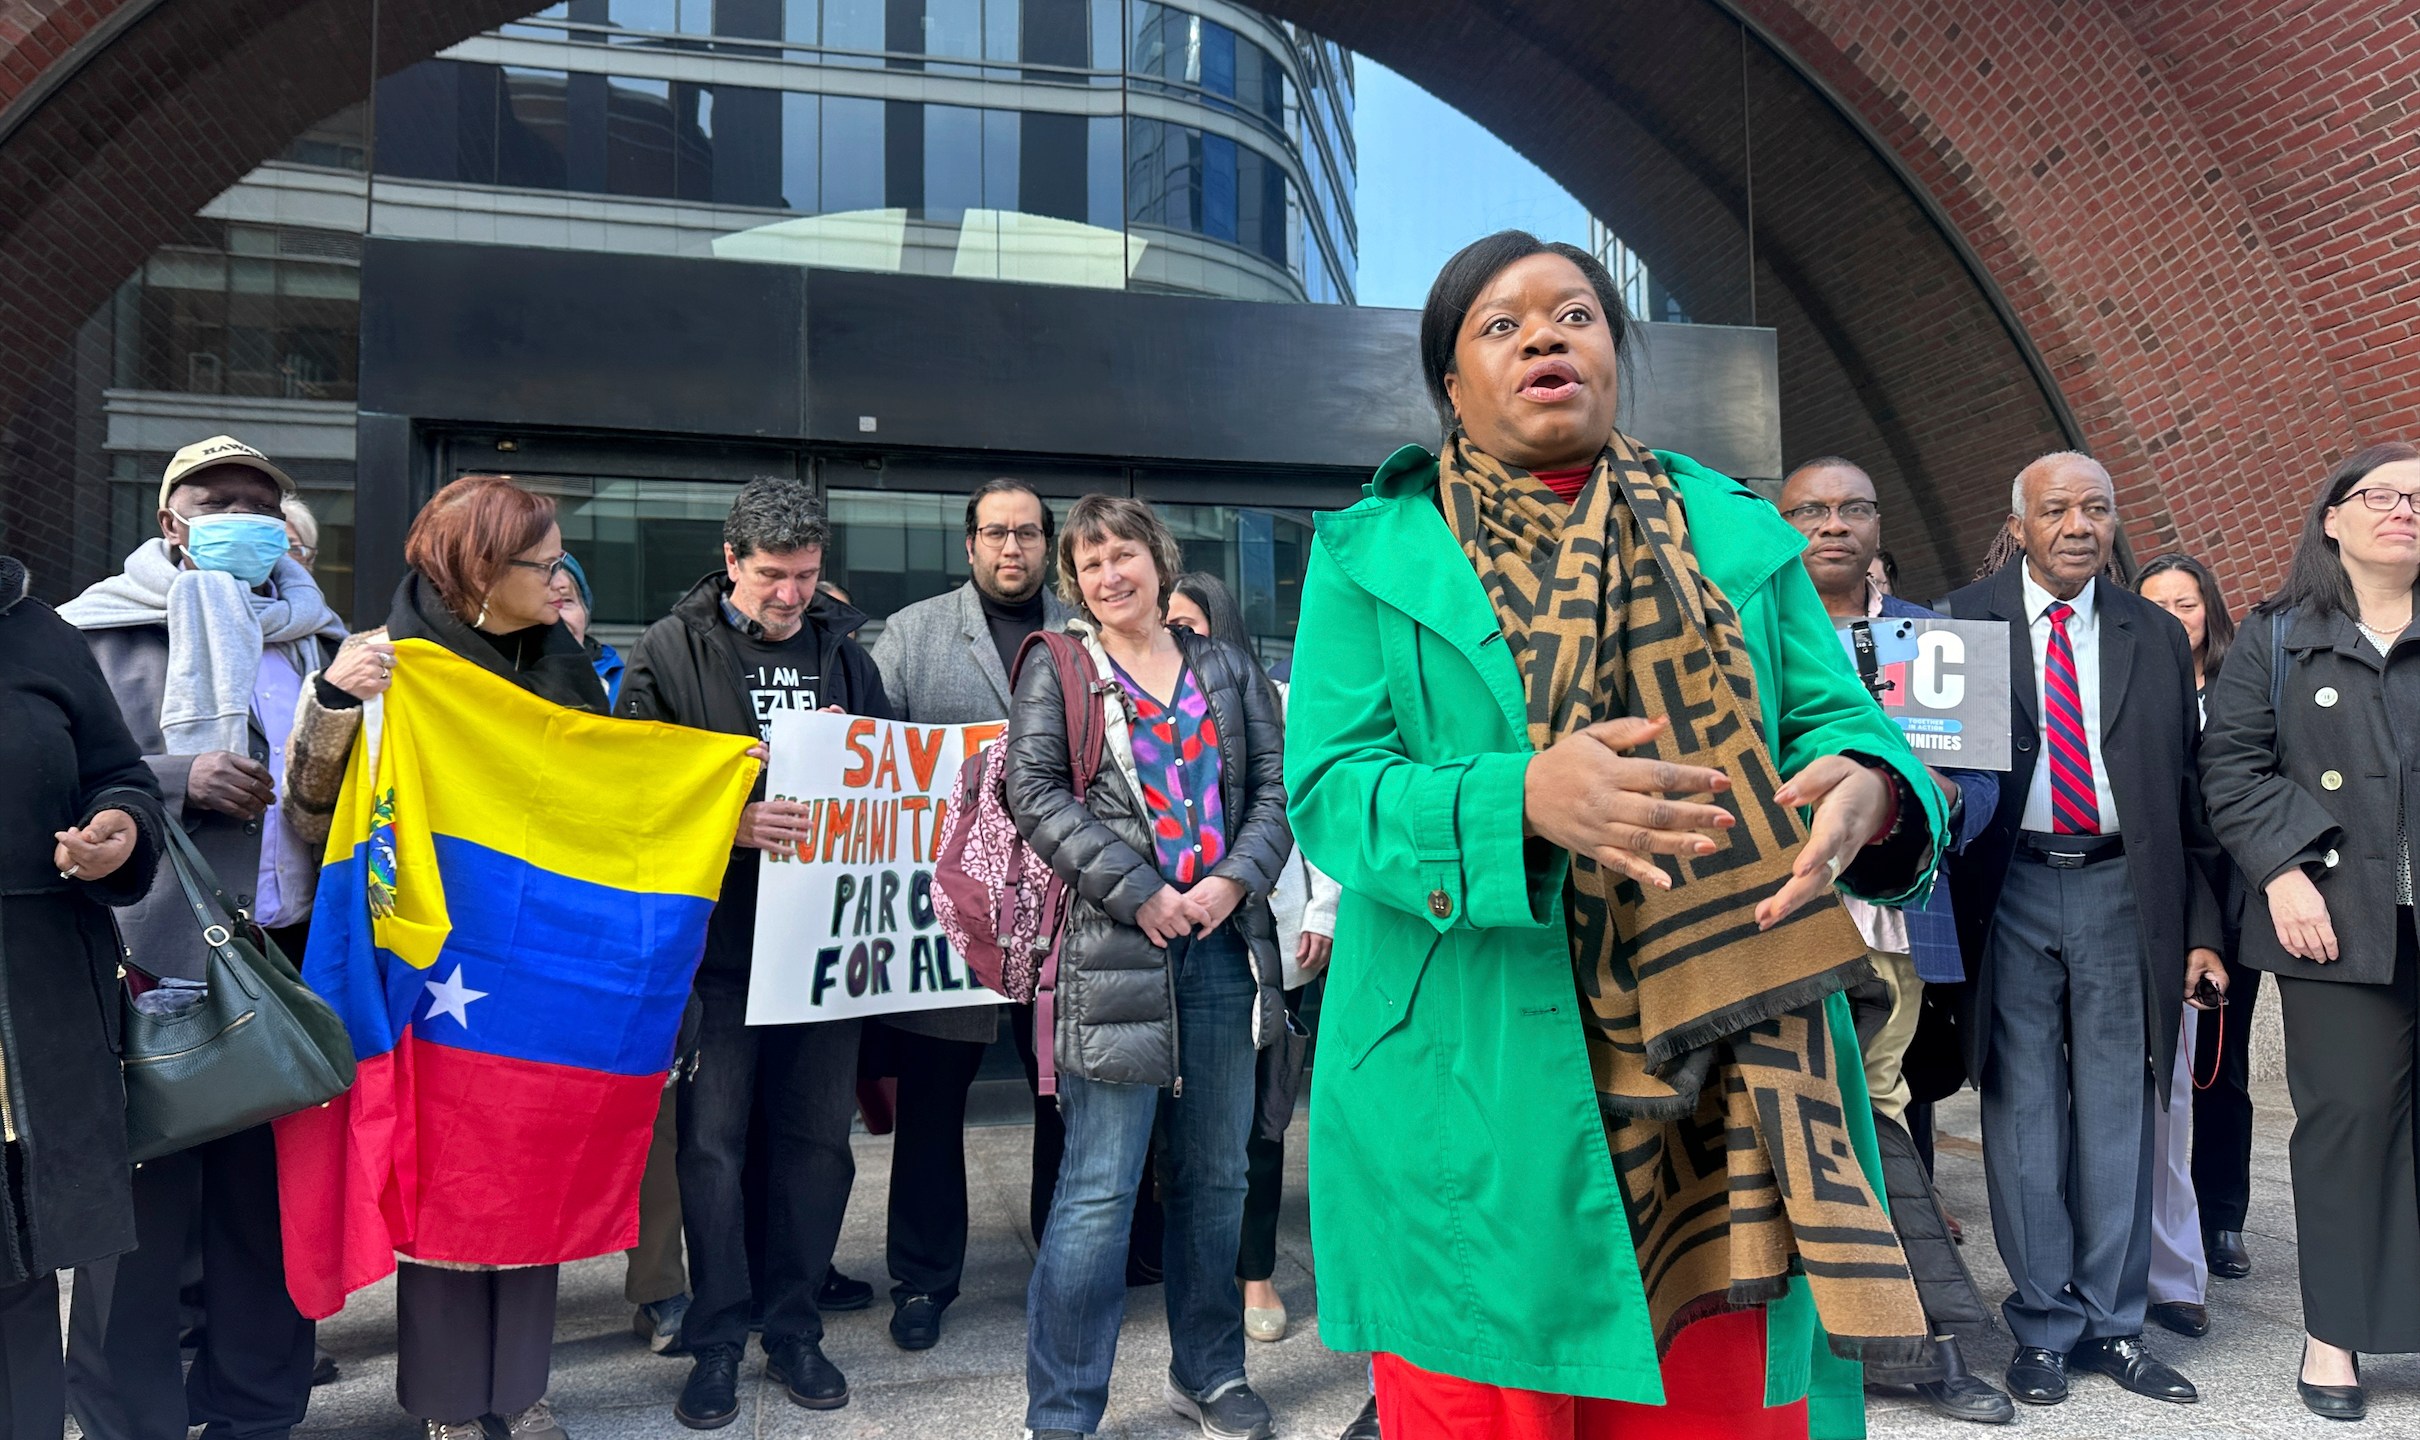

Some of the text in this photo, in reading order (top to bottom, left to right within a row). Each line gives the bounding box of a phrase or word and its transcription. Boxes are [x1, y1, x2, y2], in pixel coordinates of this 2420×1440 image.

[759, 666, 800, 687] I AM
[749, 689, 817, 720] EZUE
[1908, 717, 1944, 726] TOGETHER
[1917, 724, 1944, 732] ACTION
[1902, 732, 1962, 751] UNITIES
[810, 936, 895, 1006] FOR
